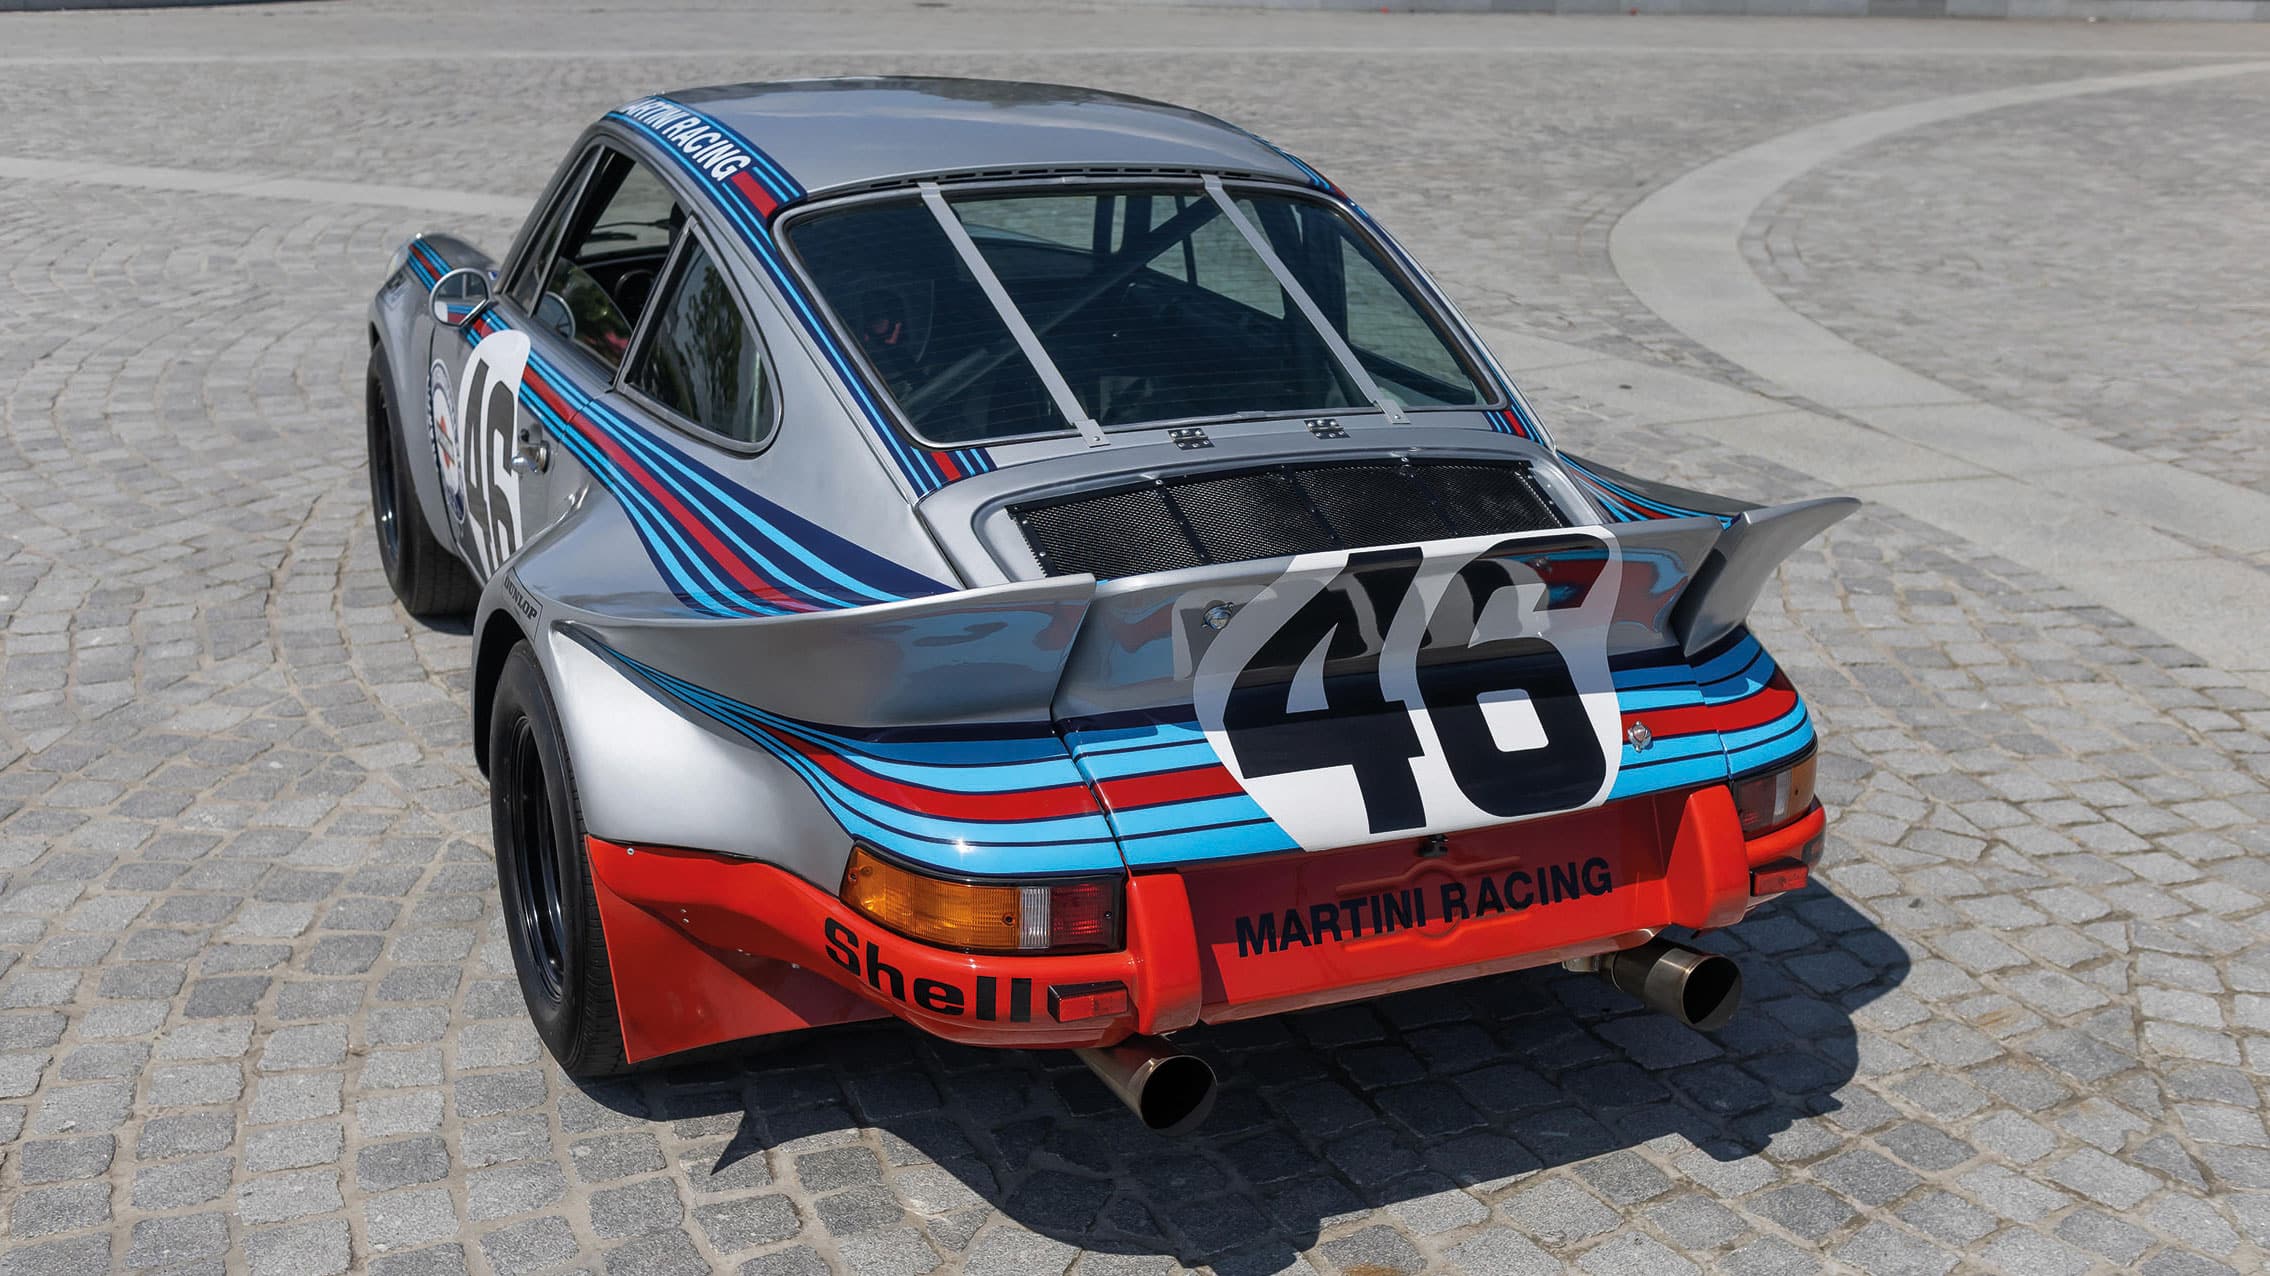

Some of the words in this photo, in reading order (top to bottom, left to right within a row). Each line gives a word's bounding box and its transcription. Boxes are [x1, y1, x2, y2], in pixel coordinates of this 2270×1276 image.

[661, 116, 752, 181] RACING
[464, 358, 516, 572] 46
[503, 575, 538, 621] DUNLOP
[1222, 533, 1612, 835] 46
[1234, 886, 1427, 958] MARTINI
[1440, 856, 1614, 923] RACING
[825, 917, 1032, 1023] Shell
